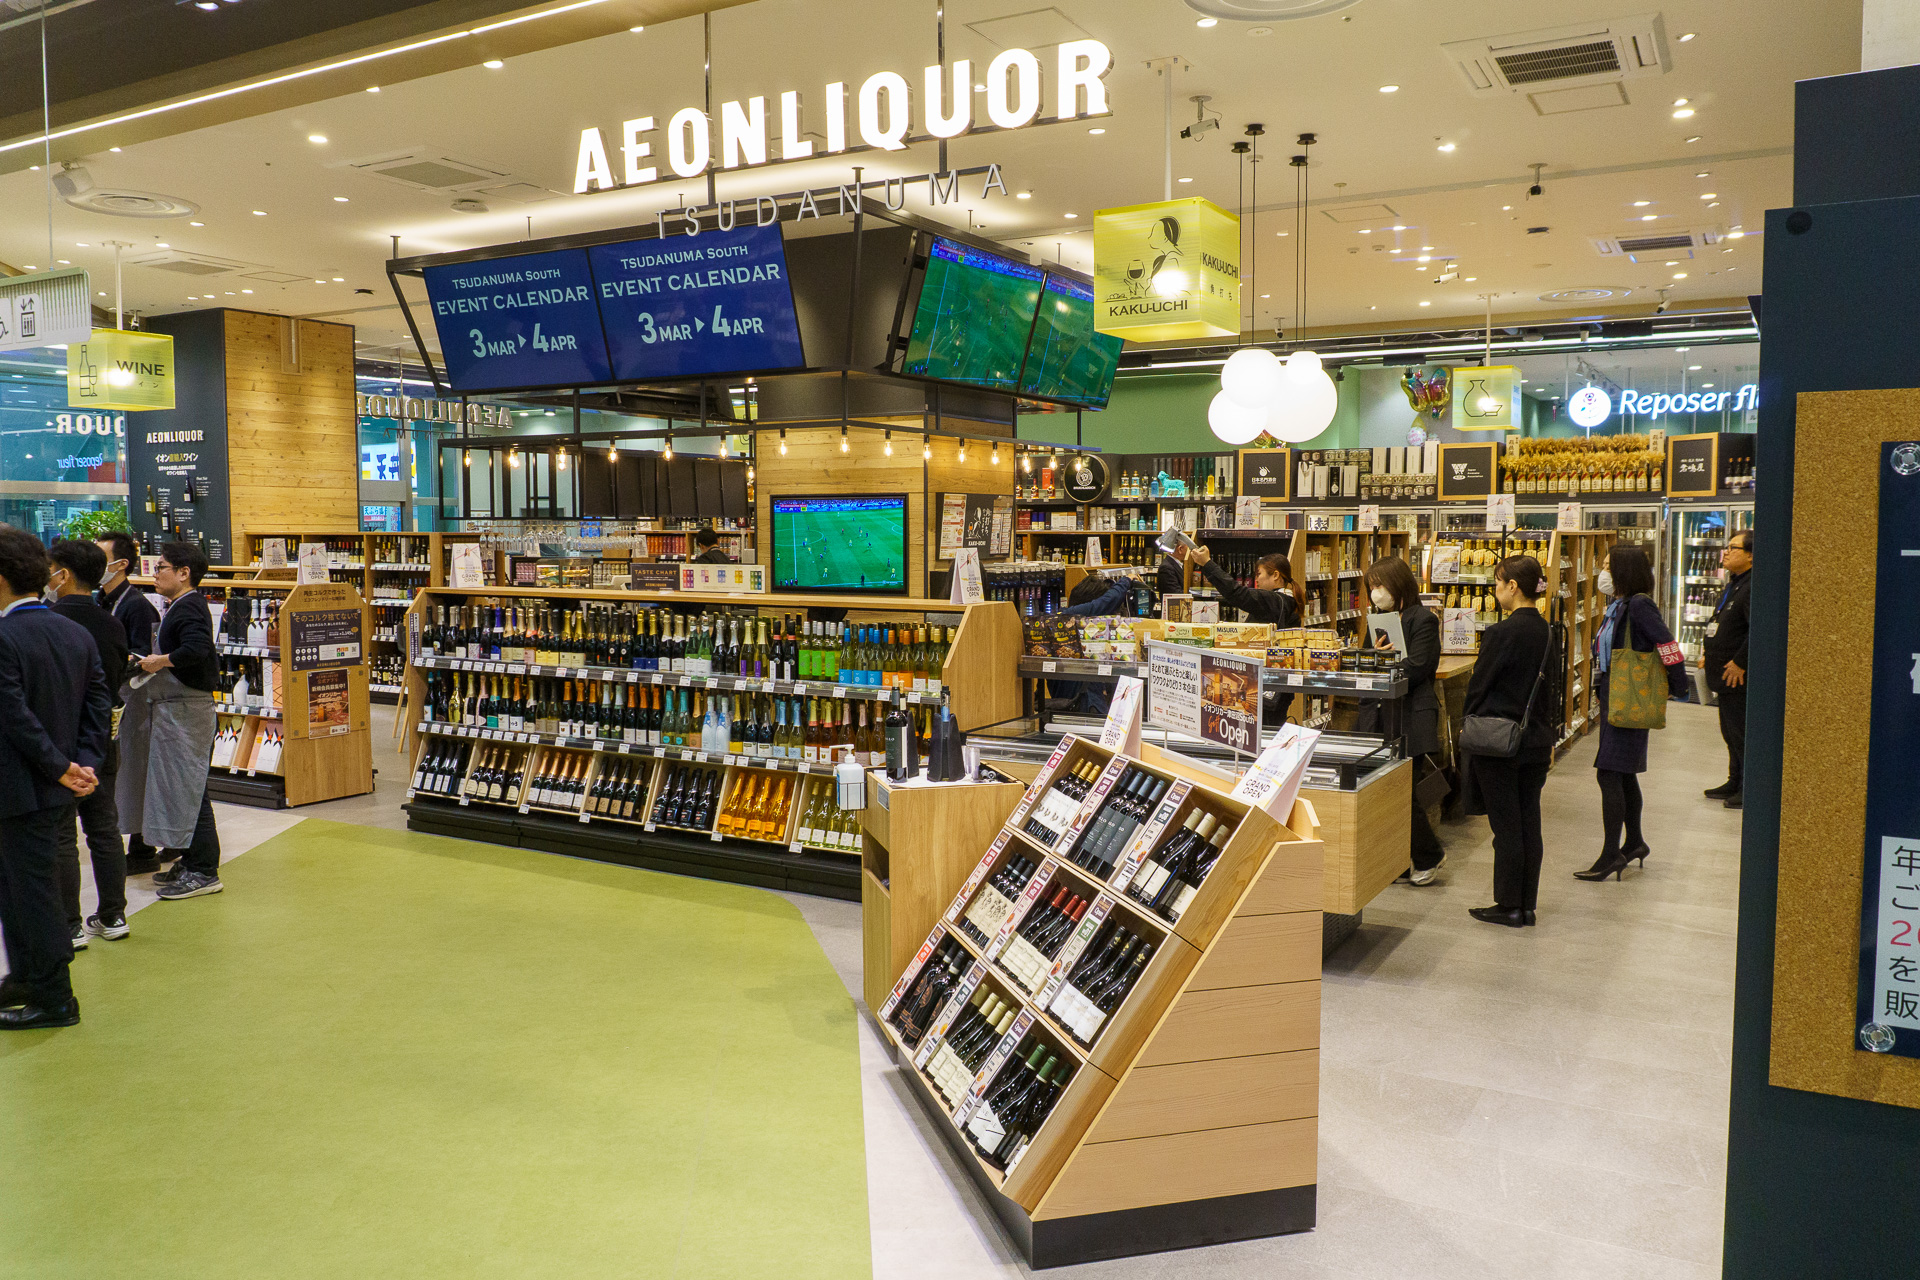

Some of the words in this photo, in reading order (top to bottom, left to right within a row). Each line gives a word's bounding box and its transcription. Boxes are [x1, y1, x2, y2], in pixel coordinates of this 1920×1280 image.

[573, 39, 1114, 194] AEONLIQUOR
[655, 164, 1008, 240] TSUDANUMA
[621, 249, 705, 270] TSUDANUMA
[1202, 252, 1239, 279] KAKU-UCHI
[452, 272, 523, 290] TSUDANUMA
[601, 276, 662, 298] EVENT
[667, 263, 781, 291] CALENDAR
[436, 296, 488, 316] EVENT
[493, 286, 589, 310] CALENDAR
[1109, 299, 1188, 317] KAKU-UCHI
[116, 360, 165, 376] WINE
[1618, 389, 1731, 420] Reposer
[1732, 384, 1759, 412] fl
[146, 430, 204, 443] AEONLIQUOR
[1212, 657, 1247, 671] AEONLIQUOR
[1219, 719, 1249, 746] Open
[1243, 786, 1263, 799] OPEN
[1245, 779, 1271, 793] GRAND
[1891, 845, 1920, 876] 年
[1889, 956, 1919, 983] を
[1884, 989, 1920, 1021] 販
